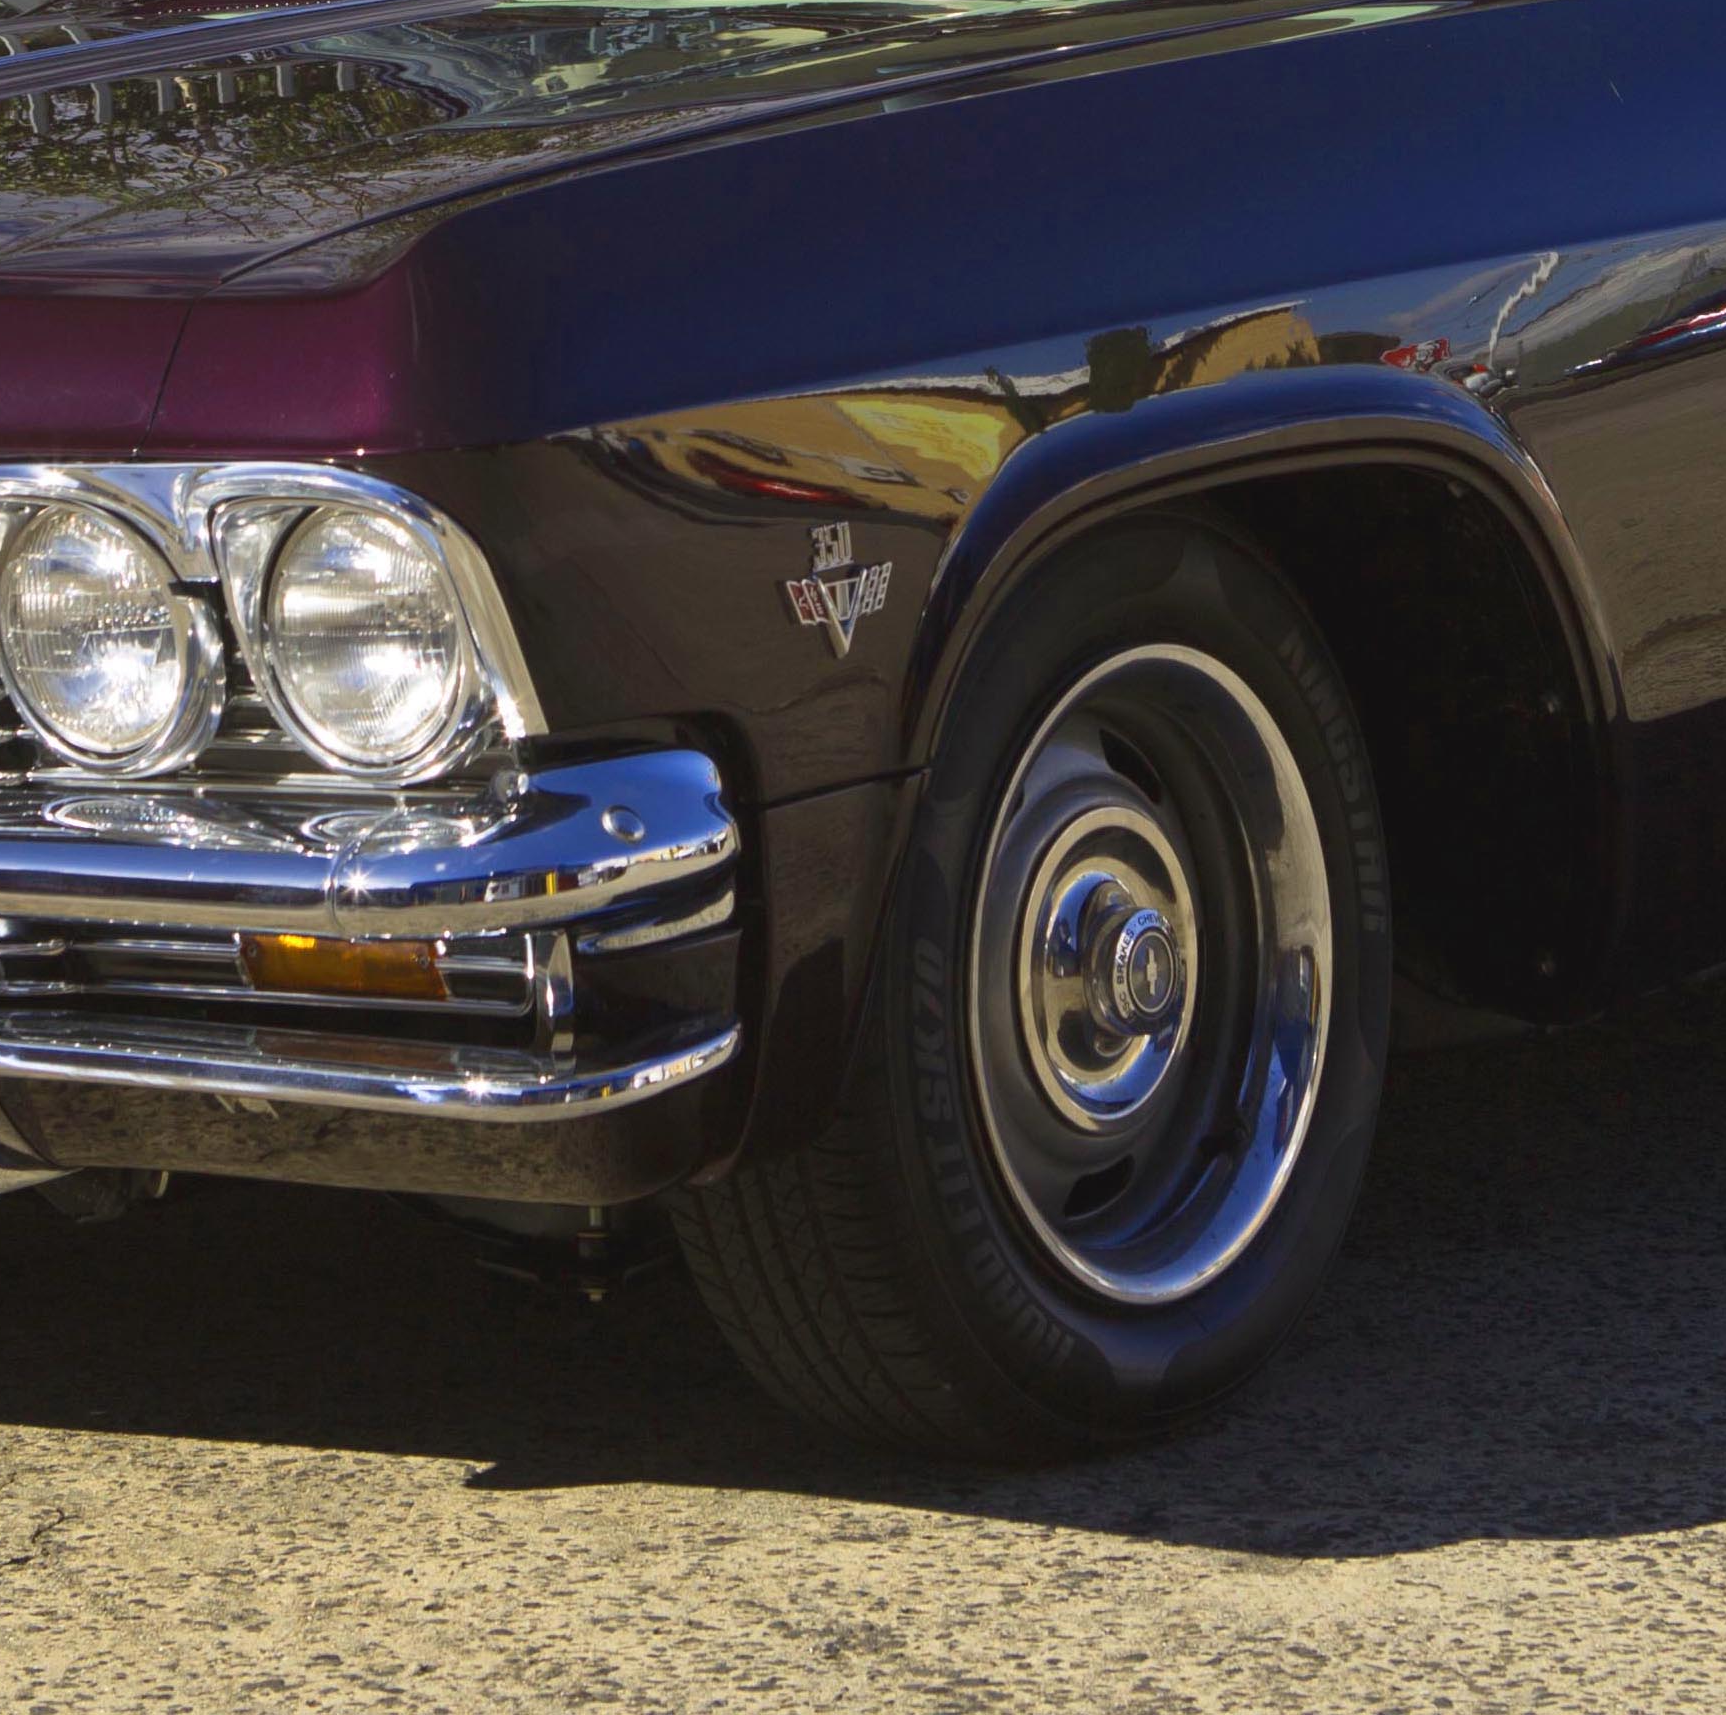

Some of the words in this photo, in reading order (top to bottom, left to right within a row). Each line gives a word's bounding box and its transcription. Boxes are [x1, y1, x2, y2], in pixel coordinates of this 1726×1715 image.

[812, 521, 854, 571] 350
[1116, 928, 1135, 985] BRAKES
[912, 936, 955, 1121] SK70
